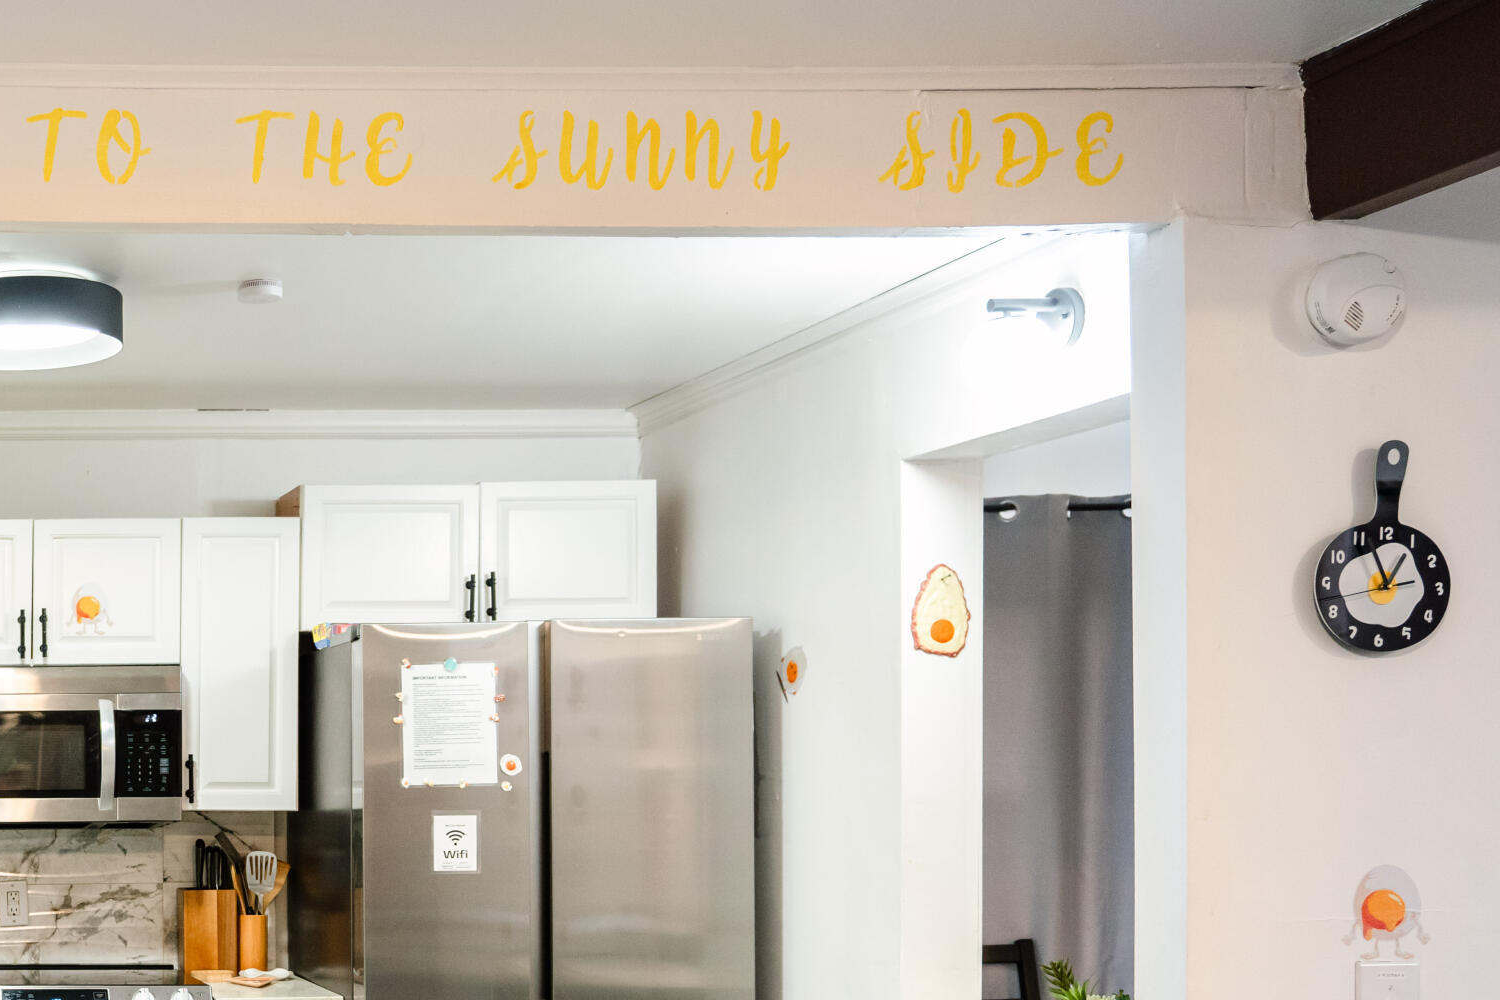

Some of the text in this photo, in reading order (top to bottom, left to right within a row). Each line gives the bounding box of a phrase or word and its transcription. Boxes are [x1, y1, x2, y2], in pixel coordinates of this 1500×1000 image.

[27, 108, 151, 184] TO
[236, 110, 412, 186] THE
[492, 110, 790, 191] SUNNY
[879, 108, 1124, 193] SIDE
[1353, 531, 1365, 546] 11
[1379, 526, 1394, 541] 12
[1410, 534, 1415, 549] 1
[1330, 549, 1346, 564] 10
[1427, 554, 1437, 569] 2
[1321, 576, 1331, 591] 9
[1434, 581, 1444, 596] 3
[1328, 604, 1339, 619] 8
[1423, 609, 1433, 623] 4
[1348, 625, 1358, 639] 7
[1401, 626, 1412, 640] 5
[1373, 633, 1384, 648] 6
[443, 849, 468, 859] Wifi
